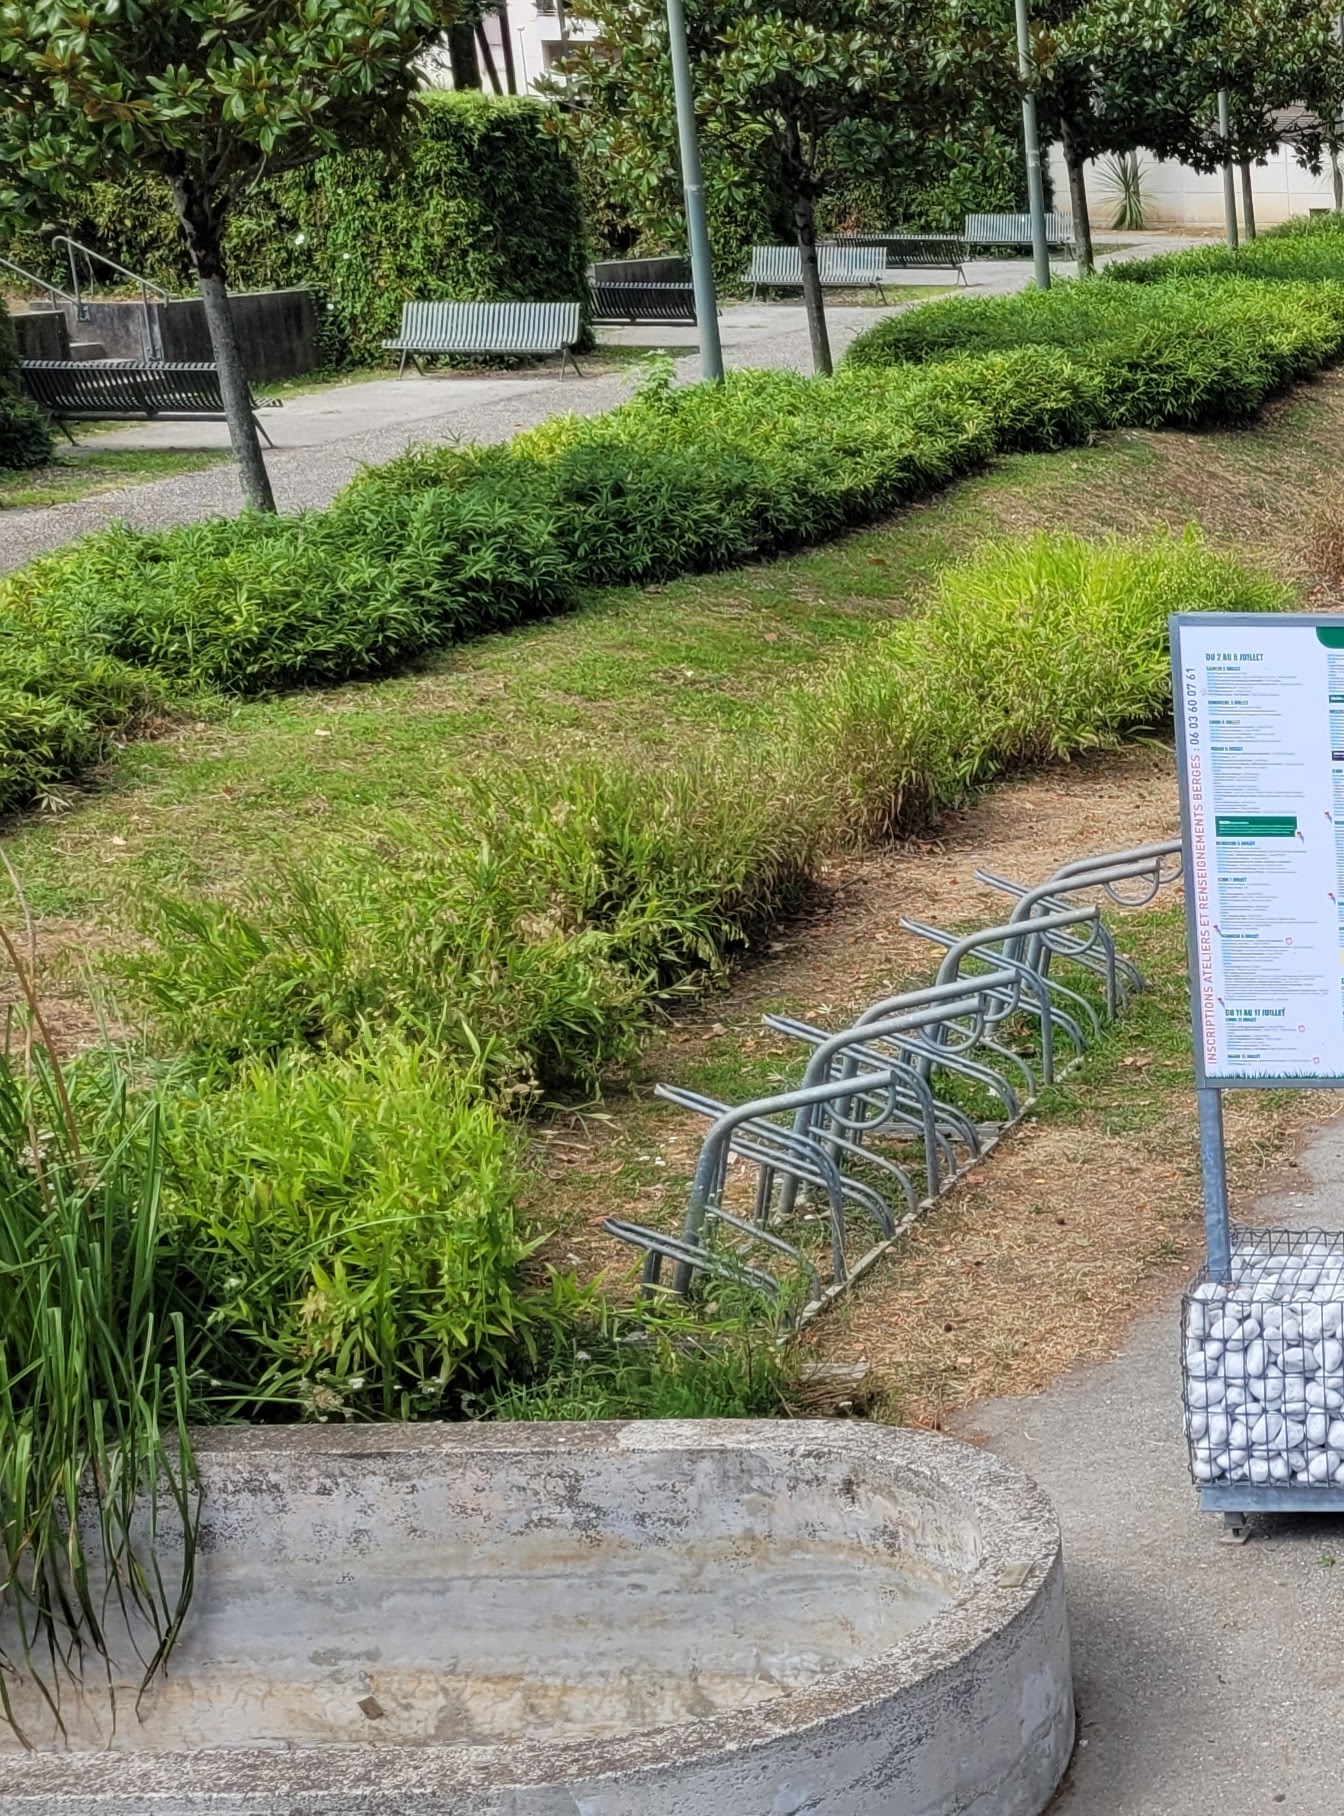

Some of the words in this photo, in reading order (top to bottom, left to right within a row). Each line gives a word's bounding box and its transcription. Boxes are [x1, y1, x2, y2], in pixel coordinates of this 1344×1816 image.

[1185, 667, 1196, 681] 61
[1186, 682, 1197, 696] 07
[1187, 699, 1198, 713] 60
[1188, 716, 1199, 729] 03
[1189, 731, 1200, 746] 06
[1190, 754, 1202, 801] BERGES
[1192, 803, 1209, 910] RENSEIGNEMENTS
[1200, 912, 1210, 927] ET
[1200, 929, 1212, 984] ATELIERS
[1204, 987, 1217, 1065] INSCRIPTIONS
